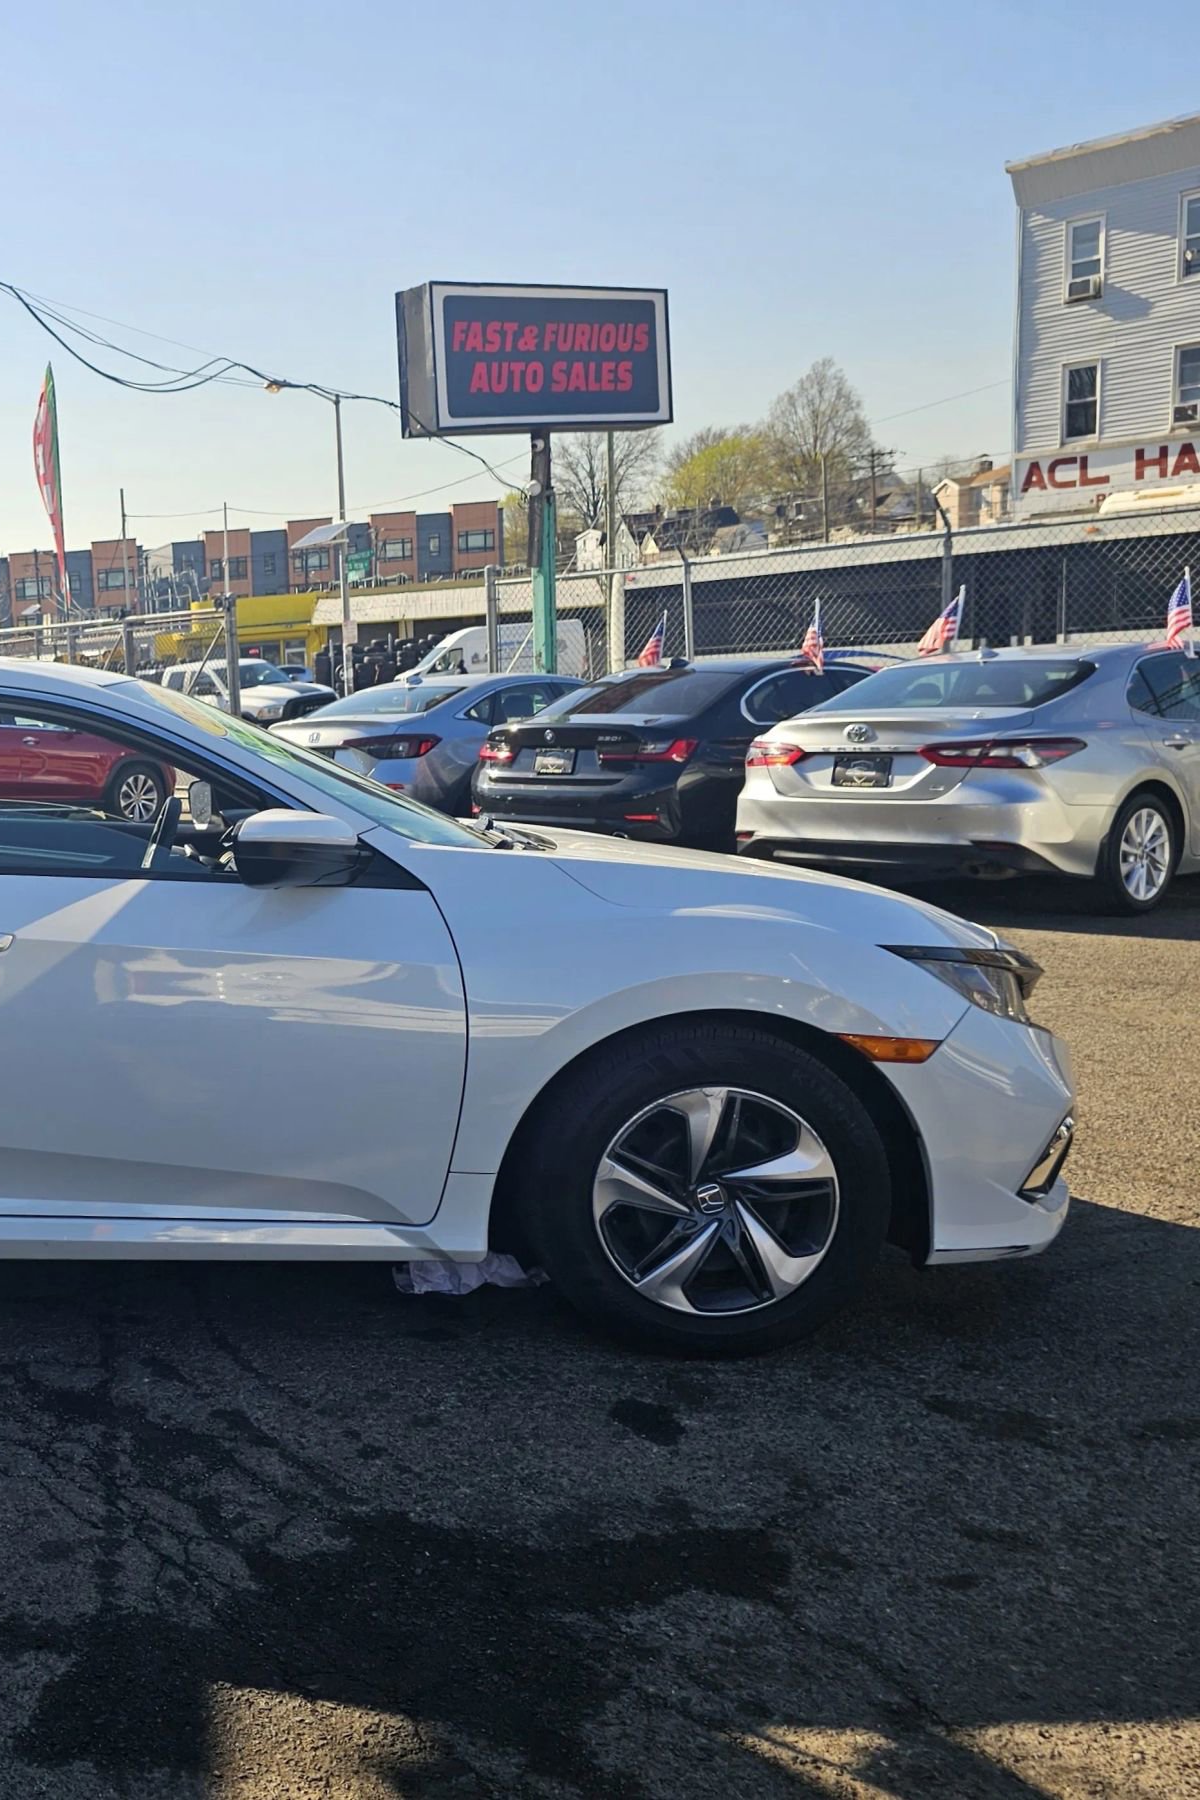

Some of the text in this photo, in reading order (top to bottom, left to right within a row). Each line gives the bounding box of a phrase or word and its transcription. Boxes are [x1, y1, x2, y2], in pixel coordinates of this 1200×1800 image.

[452, 321, 649, 353] FAST & FURIOUS
[469, 360, 633, 393] AUTO SALES
[1021, 455, 1110, 493] ACL
